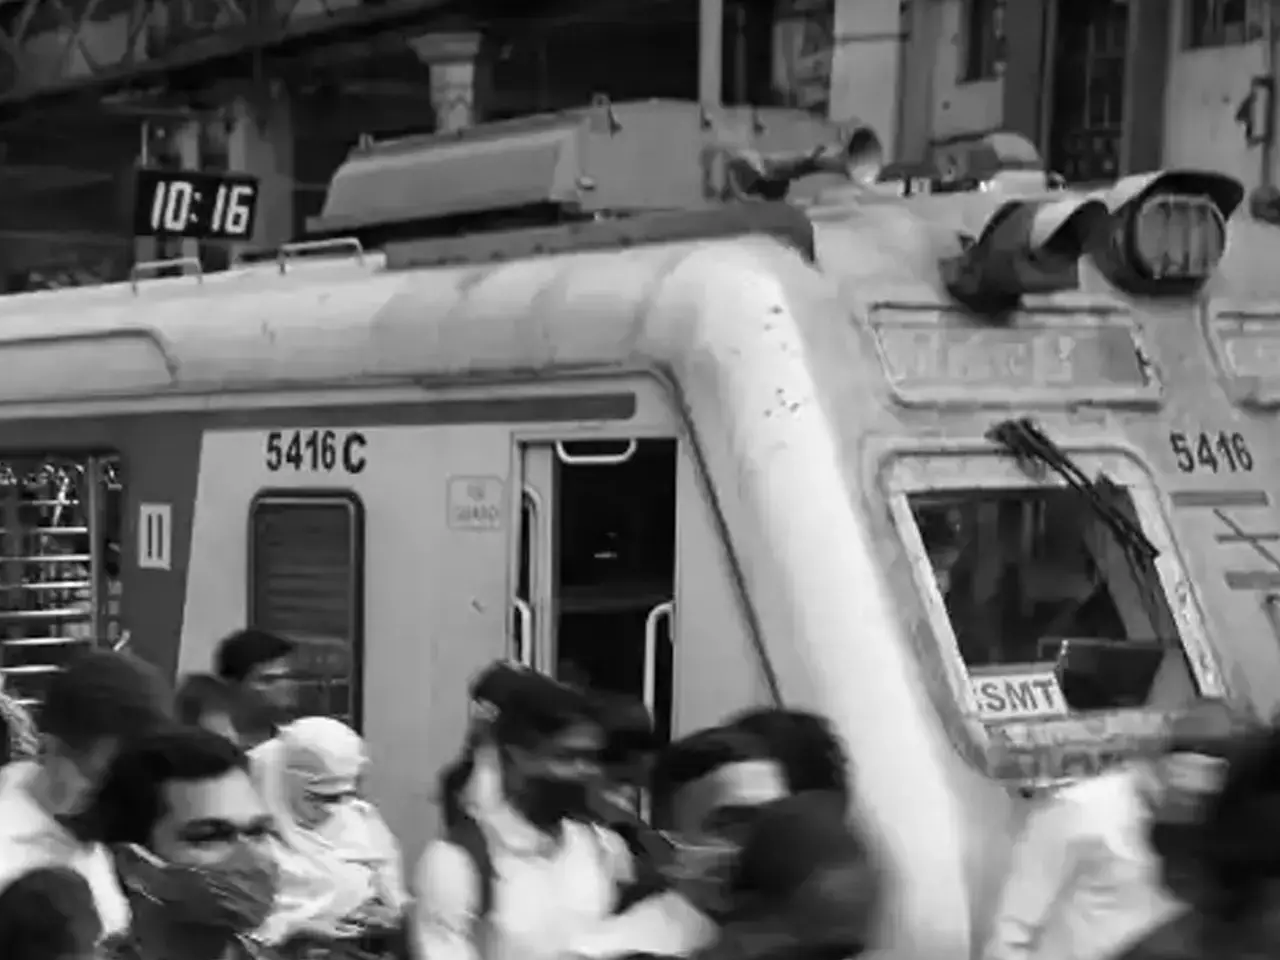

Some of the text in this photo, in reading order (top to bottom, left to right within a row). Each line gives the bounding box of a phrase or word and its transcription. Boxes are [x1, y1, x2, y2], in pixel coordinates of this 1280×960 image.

[150, 181, 253, 234] 10:16
[1170, 430, 1253, 475] 5416
[972, 679, 1055, 712] SMT
